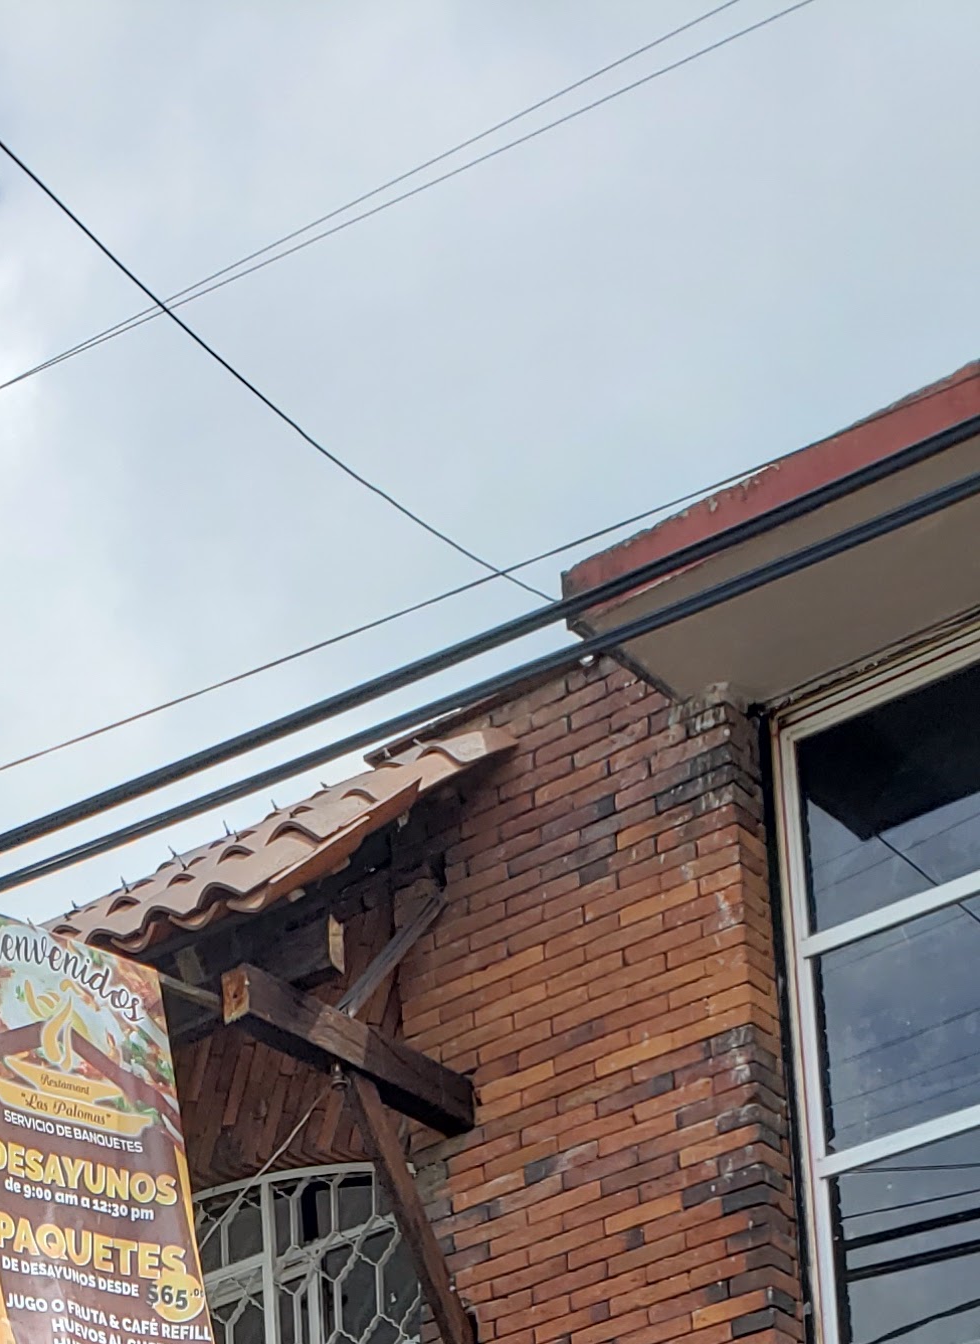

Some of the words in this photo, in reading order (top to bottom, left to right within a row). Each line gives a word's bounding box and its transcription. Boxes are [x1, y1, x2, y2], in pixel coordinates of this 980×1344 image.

[4, 1109, 55, 1135] SERVICIO
[56, 1125, 73, 1139] DE
[73, 1128, 144, 1154] BANQUETES
[4, 1176, 21, 1193] de
[23, 1186, 52, 1201] 9:00
[54, 1191, 78, 1207] am
[80, 1196, 91, 1209] a
[92, 1199, 128, 1218] 12:30
[130, 1206, 155, 1222] pm
[2, 1255, 20, 1273] DE
[21, 1260, 96, 1289] DESAYUNOS
[98, 1278, 140, 1298] DESDE
[6, 1292, 48, 1314] JUGO
[51, 1298, 65, 1314] O
[67, 1299, 108, 1327] FRUTA
[109, 1313, 121, 1330] &
[122, 1318, 159, 1337] CAFÉ
[161, 1324, 212, 1342] REFILL
[51, 1318, 107, 1344] HUEVOS
